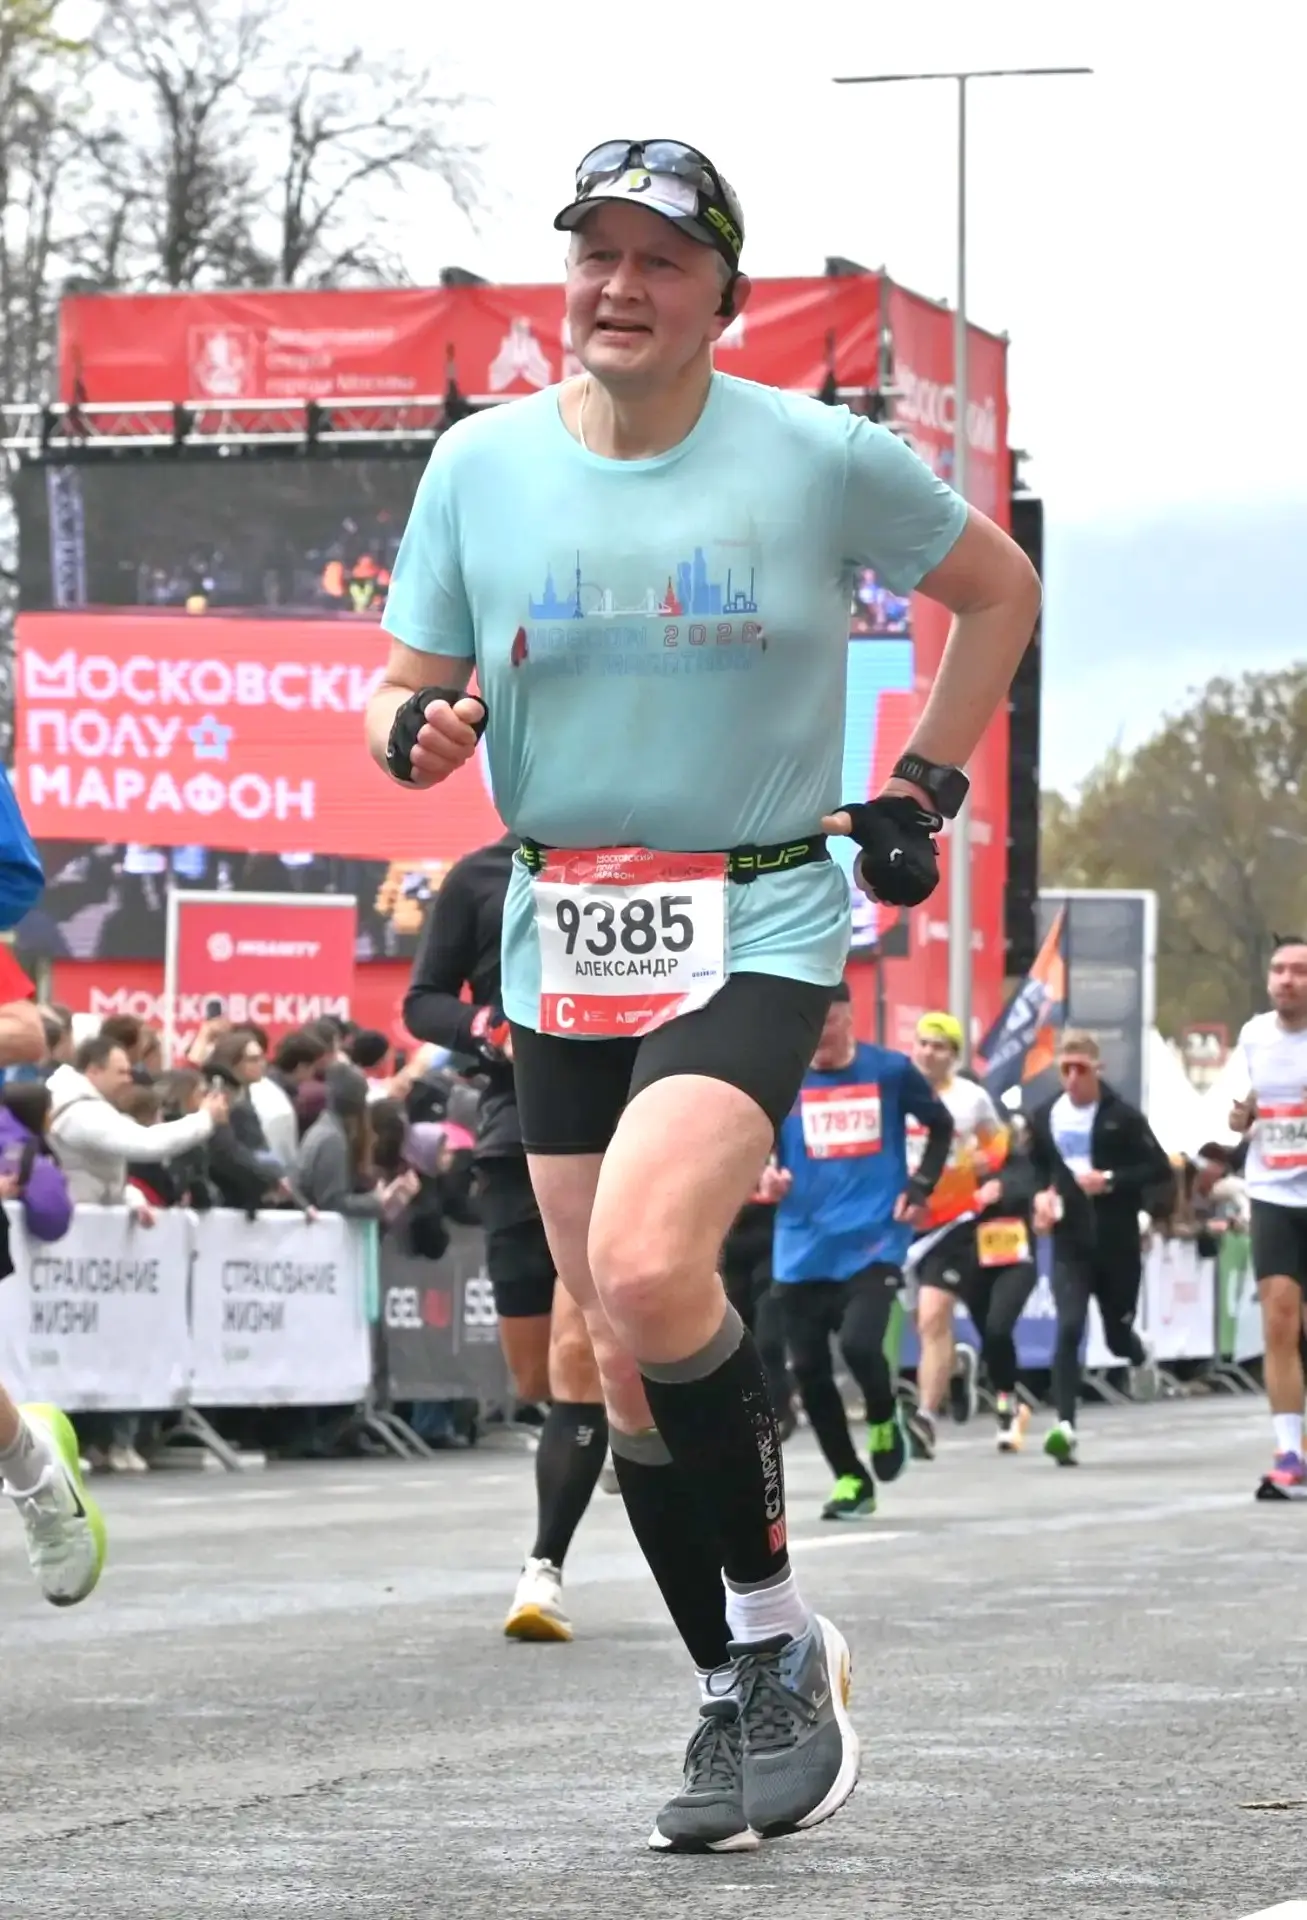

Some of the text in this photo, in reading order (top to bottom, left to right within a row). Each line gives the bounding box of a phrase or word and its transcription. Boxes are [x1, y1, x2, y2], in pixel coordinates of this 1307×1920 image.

[22, 648, 383, 713] МОСКОВСКИ
[26, 709, 183, 759] ПОЛУ
[28, 764, 316, 820] МАРАФОН
[556, 895, 694, 956] 9385
[575, 958, 679, 977] АЛЕКСАНДР
[29, 1257, 160, 1294] СТРАХОВАНИЕ
